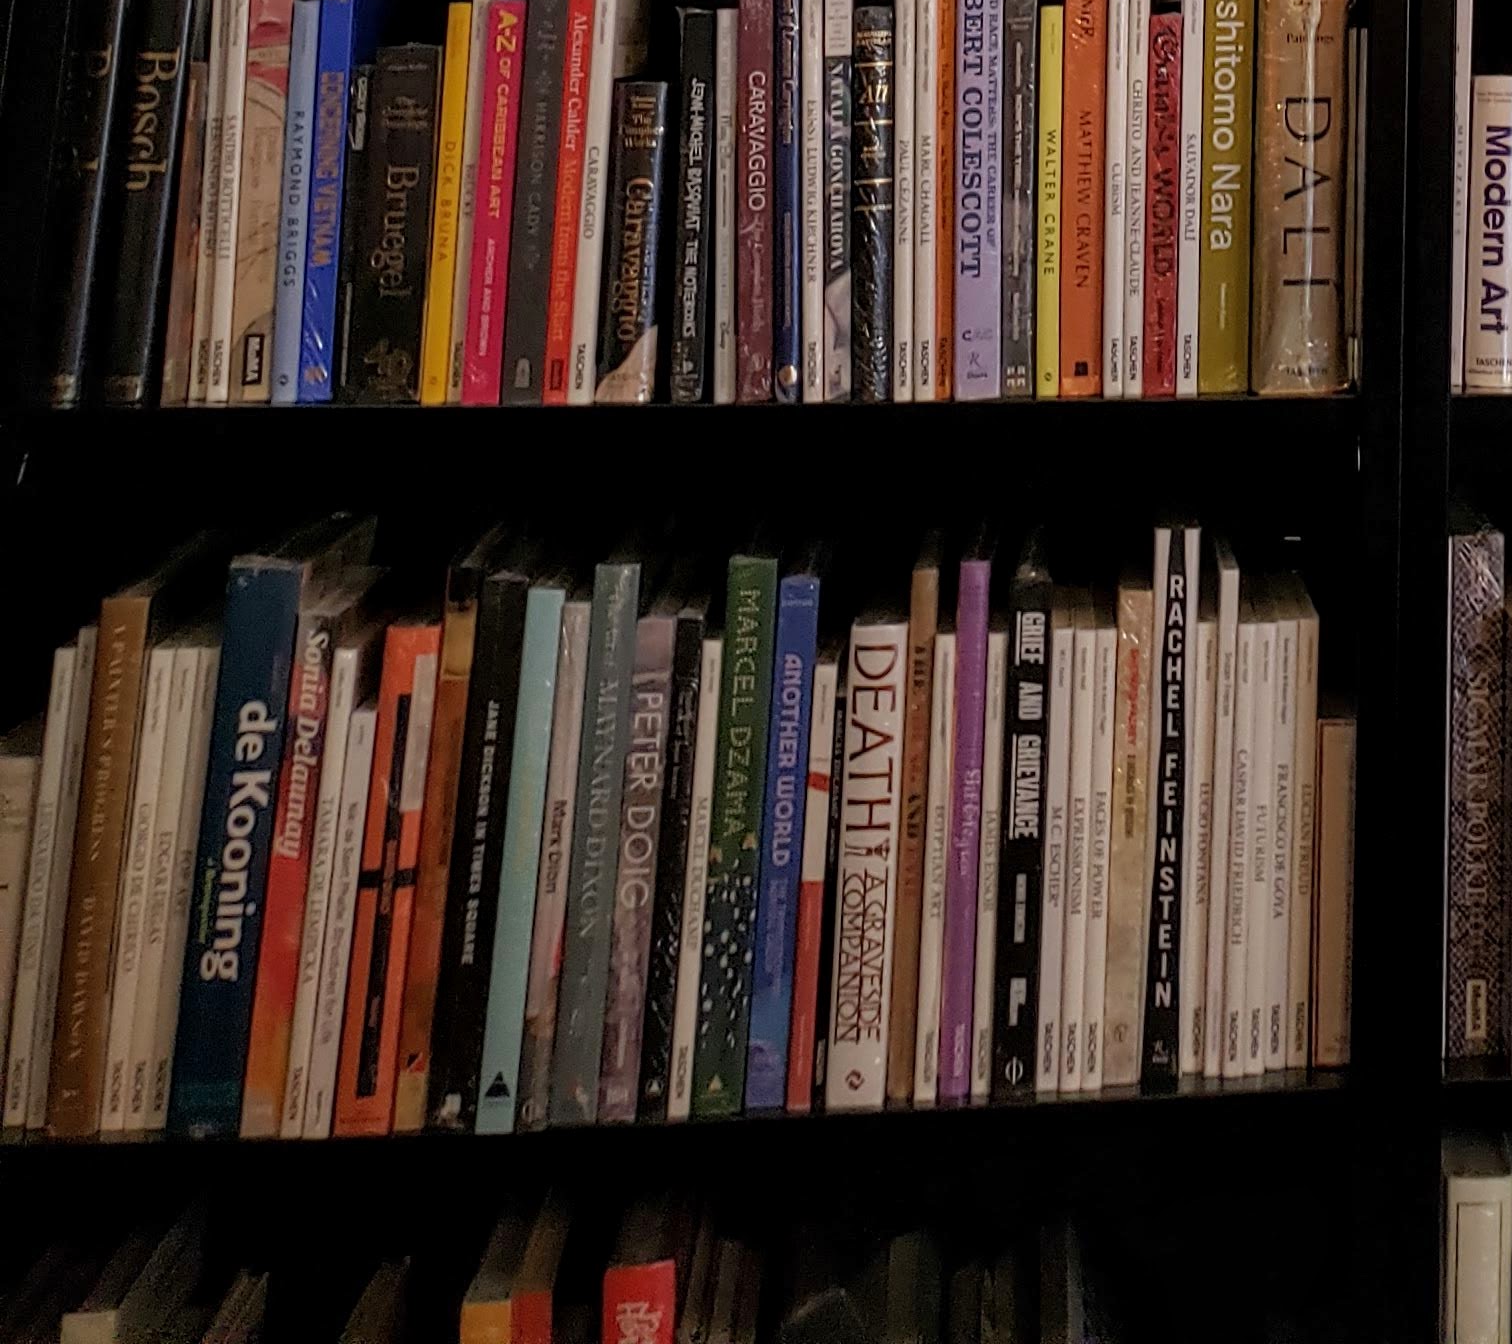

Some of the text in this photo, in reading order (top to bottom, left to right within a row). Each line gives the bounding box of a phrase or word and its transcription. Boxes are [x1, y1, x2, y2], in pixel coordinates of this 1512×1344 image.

[126, 46, 181, 193] Bosch
[487, 9, 517, 220] A-Z OF CARIBBEAN ART
[563, 11, 587, 151] Alexander Calder
[742, 70, 767, 212] CARAVAGGIO
[282, 110, 306, 289] RAYMOND BRIGGS
[370, 163, 419, 300] Bruegel
[959, 86, 986, 279] COLESCOTT
[1043, 129, 1058, 277] WALTER CRANE
[1073, 109, 1093, 290] MATTHEW CRAVEN
[1209, 162, 1240, 251] Nara
[1477, 279, 1509, 335] Art
[277, 629, 328, 861] Sonia Delaunay
[620, 691, 665, 910] PETER DOIG
[722, 588, 762, 838] MARCEL DZAMA
[771, 653, 804, 867] ANOTHER WORLD
[844, 643, 899, 834] DEATH
[1014, 611, 1047, 839] GRIEF AND GRIEVANCE
[1155, 574, 1184, 1009] RACHEL FEINSTEIN
[198, 699, 277, 983] de Kooning
[461, 700, 502, 965] JANE DICKSON IN TIMES SQUARE
[544, 799, 569, 895] Mark Dion
